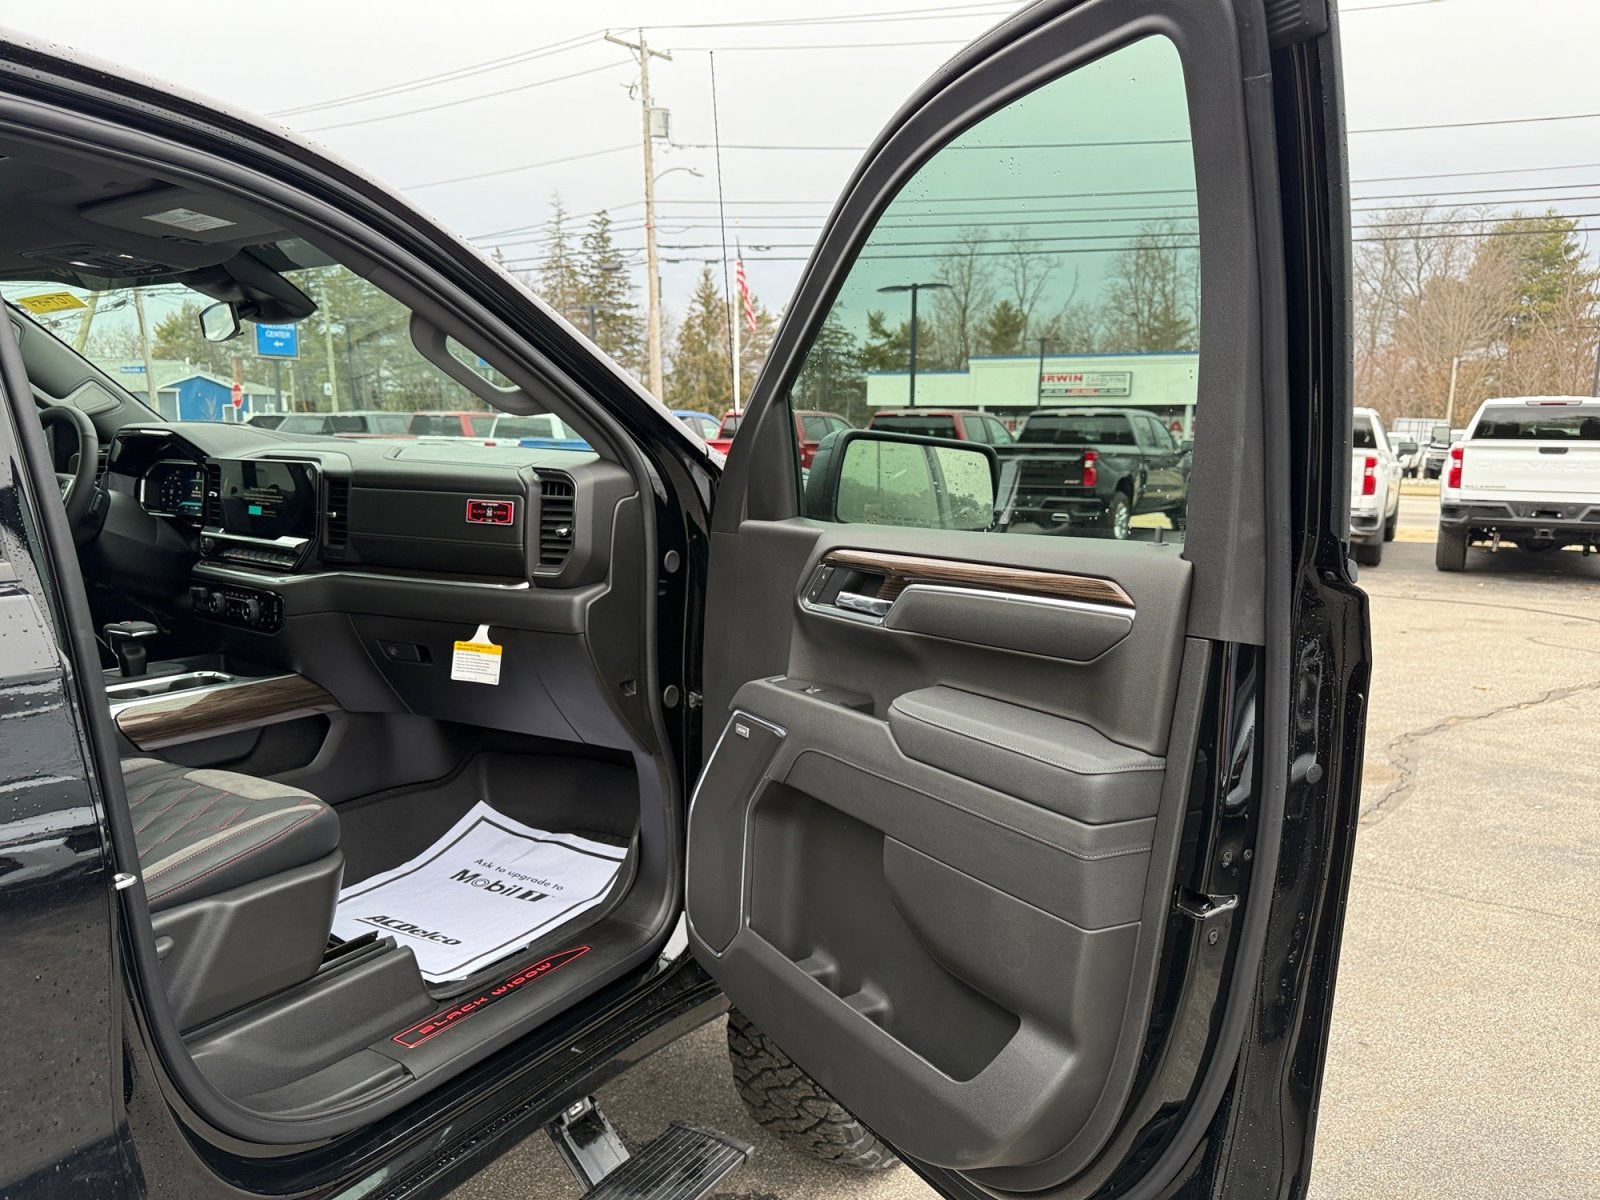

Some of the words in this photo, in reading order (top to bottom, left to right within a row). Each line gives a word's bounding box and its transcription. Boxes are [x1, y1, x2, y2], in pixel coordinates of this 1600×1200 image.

[450, 868, 524, 896] Mobil
[473, 858, 493, 869] Ask
[507, 870, 551, 887] upgrade
[552, 883, 564, 891] to
[363, 915, 462, 945] ACDelco
[419, 997, 488, 1034] BLACK
[491, 962, 551, 996] WIDOW
